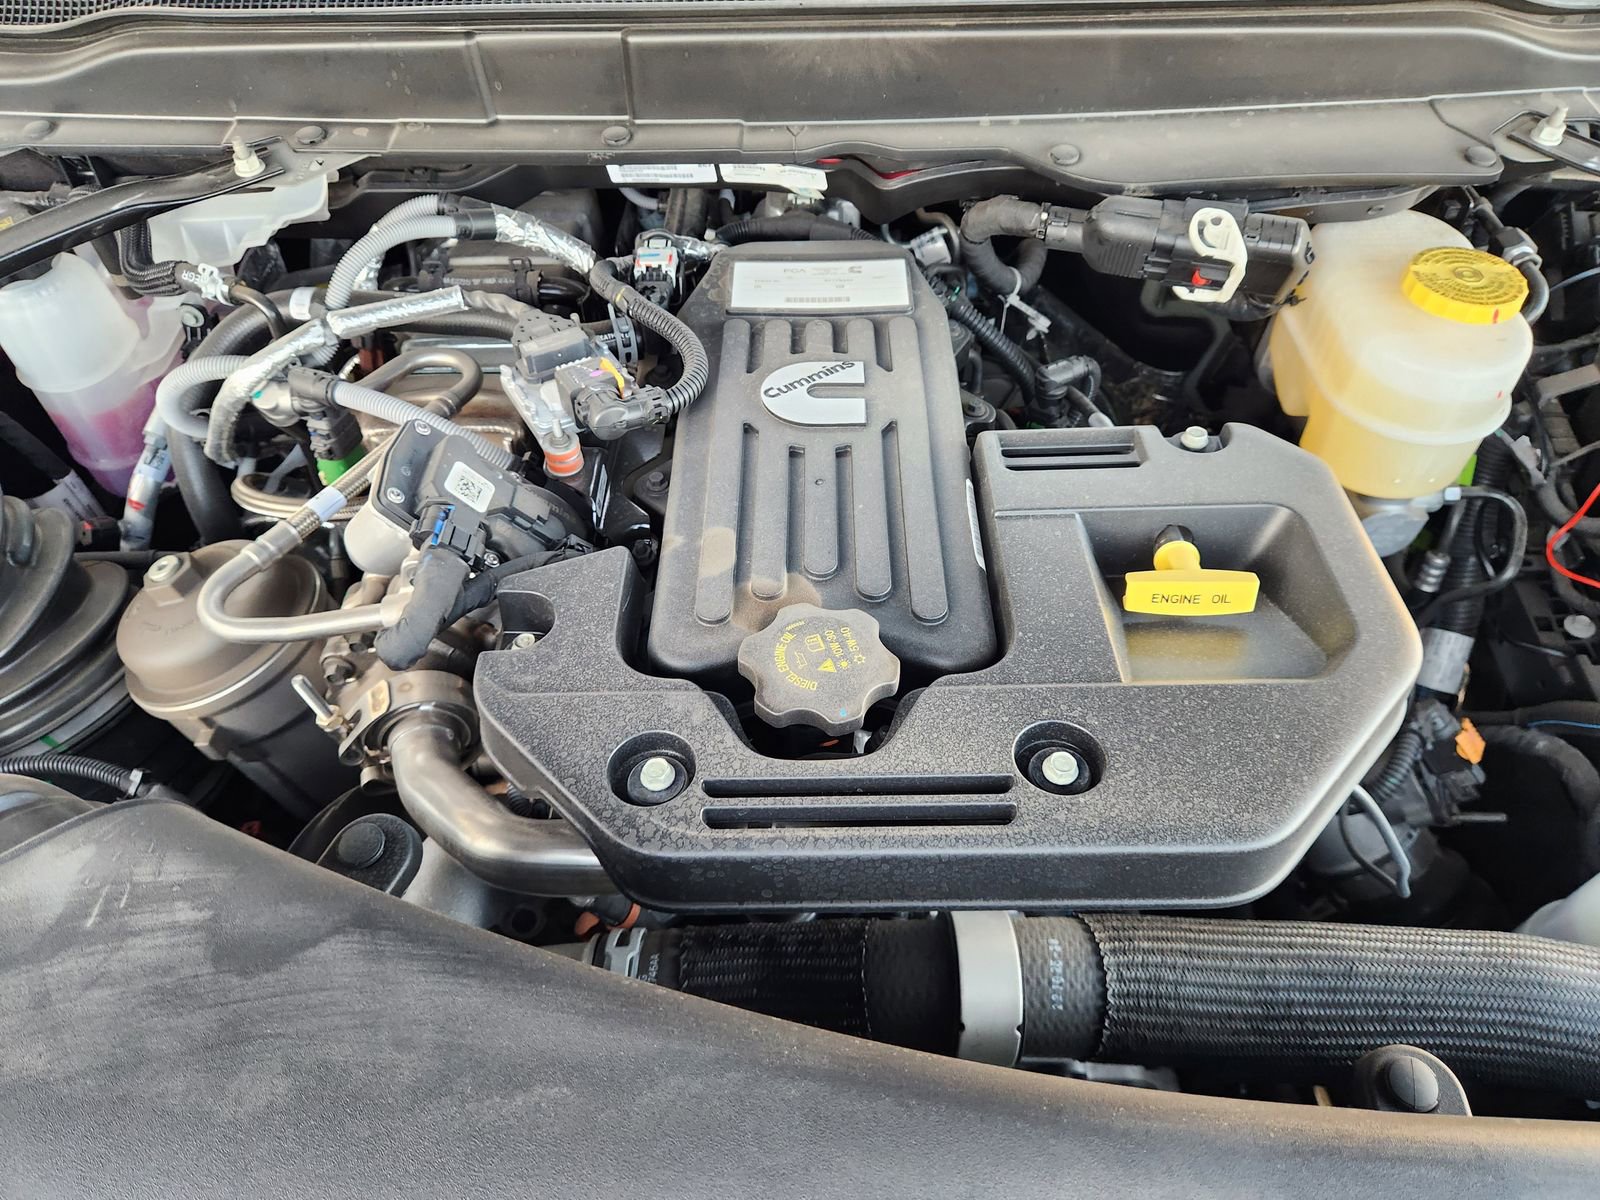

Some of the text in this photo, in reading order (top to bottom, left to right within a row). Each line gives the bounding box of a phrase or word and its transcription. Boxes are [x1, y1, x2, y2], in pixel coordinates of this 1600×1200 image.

[764, 360, 856, 399] Cummins
[1151, 593, 1232, 605] ENGINE OIL
[781, 631, 796, 645] OIL
[774, 643, 788, 673] ENGINE
[788, 670, 818, 691] DIESEL
